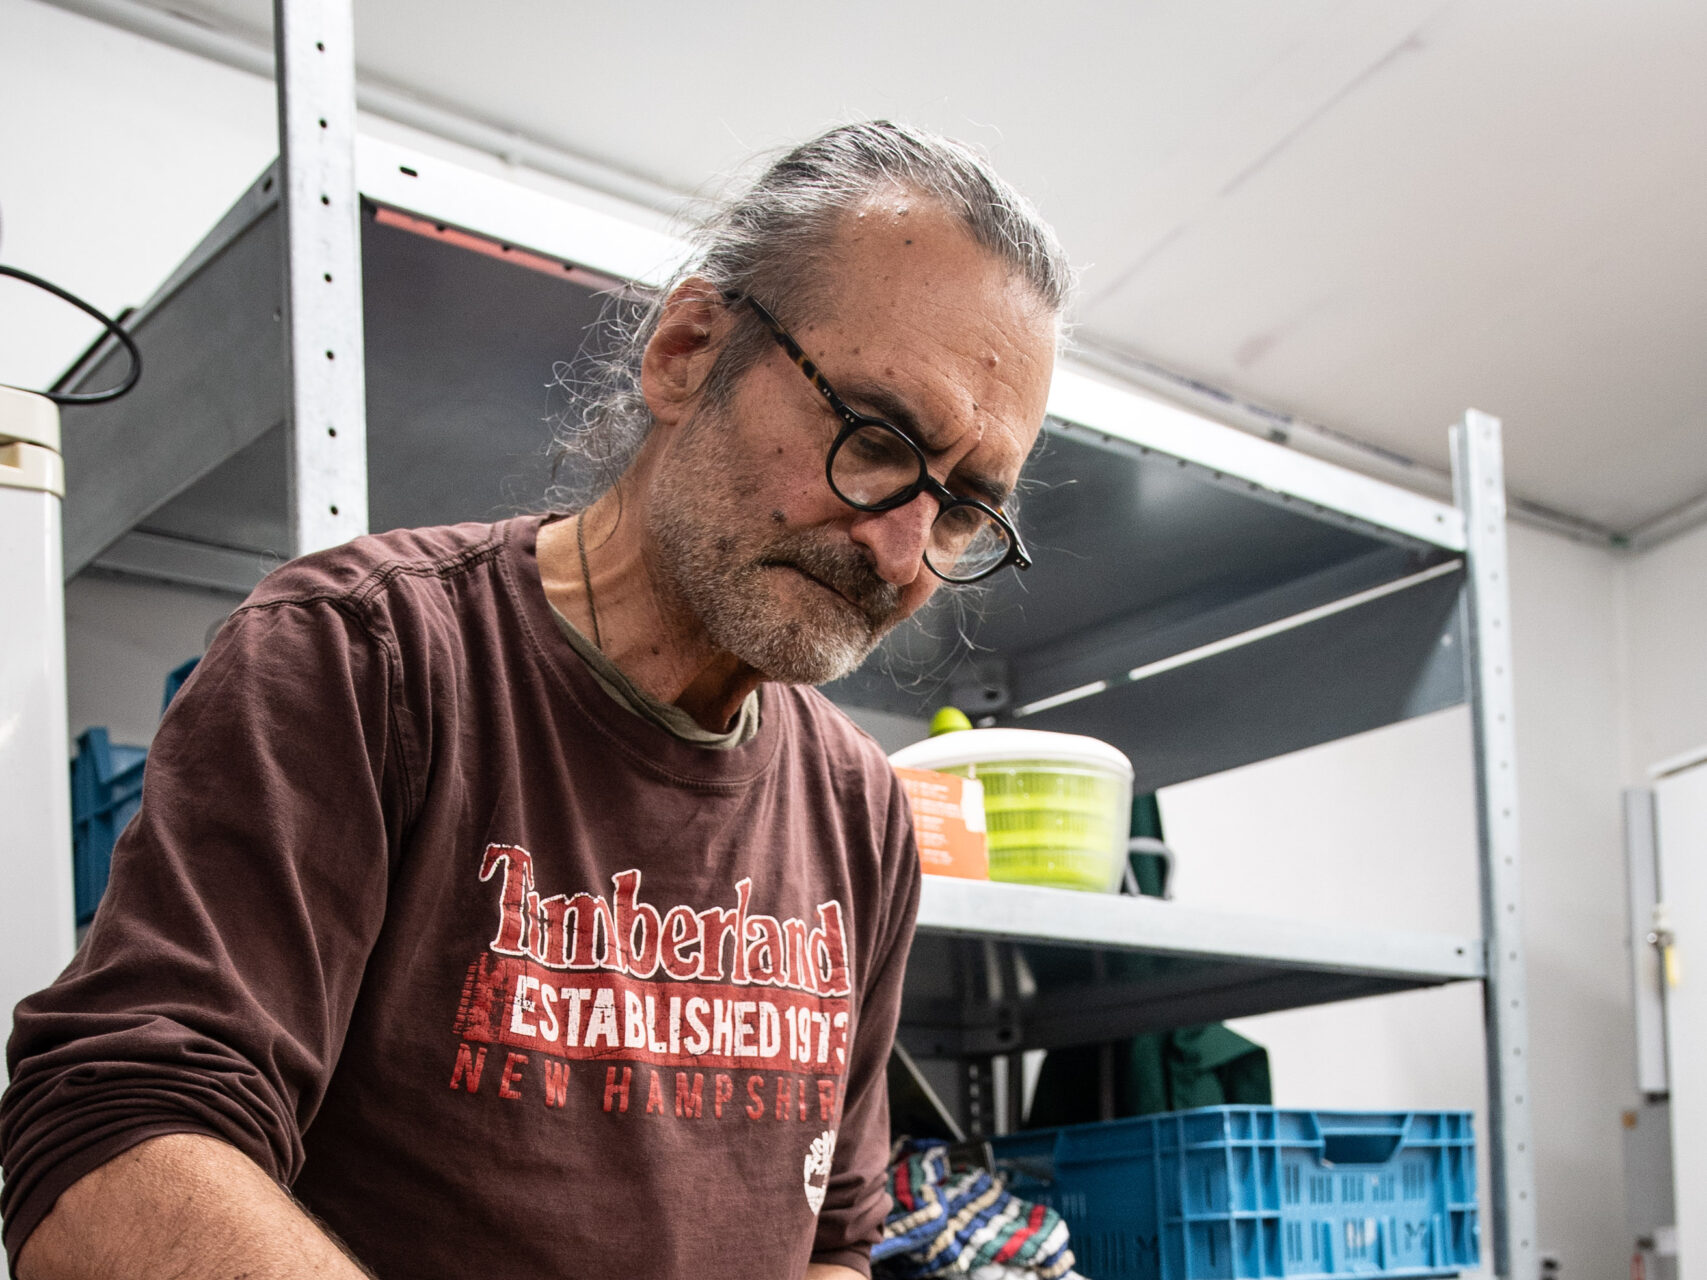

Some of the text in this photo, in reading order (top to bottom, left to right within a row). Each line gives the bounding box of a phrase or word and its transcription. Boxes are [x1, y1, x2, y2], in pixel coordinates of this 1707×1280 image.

[479, 843, 851, 997] Timberland
[510, 975, 780, 1058] ESTABLISHED
[449, 1042, 844, 1122] NEW HAMPSHIR
